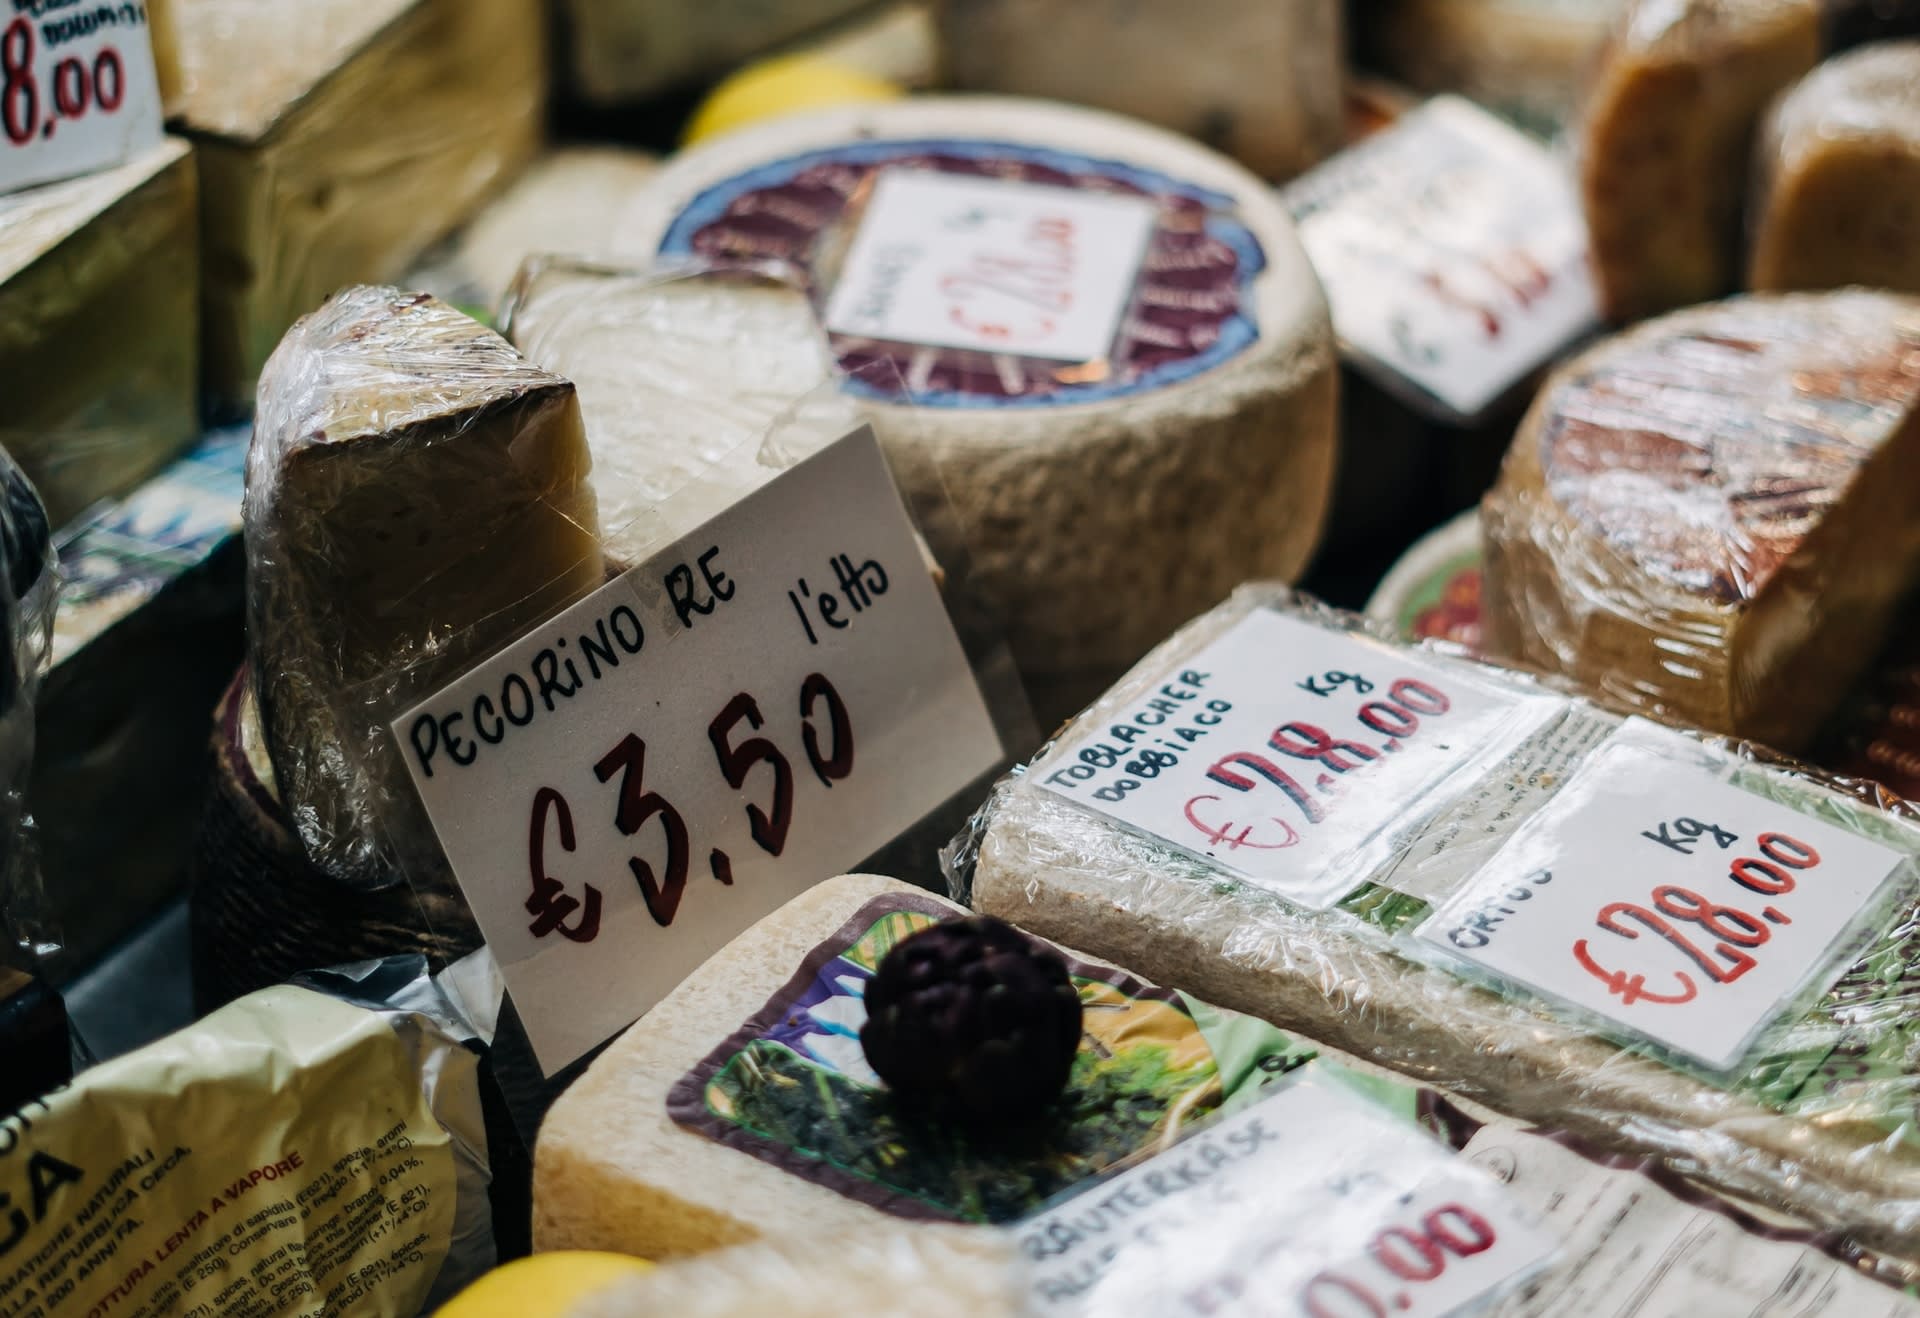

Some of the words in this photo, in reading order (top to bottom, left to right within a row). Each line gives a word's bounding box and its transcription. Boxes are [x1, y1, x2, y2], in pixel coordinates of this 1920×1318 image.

[663, 545, 737, 629] RE
[1044, 669, 1212, 789] TOBLACHER
[76, 1148, 156, 1227] NATURALI
[155, 1208, 210, 1262] LENTA
[211, 1197, 226, 1213] A
[224, 1150, 305, 1202] VAPORE
[233, 1221, 247, 1238] di
[246, 1199, 296, 1229] sapidità
[376, 1119, 408, 1149] aromi
[76, 1239, 119, 1281] ANNI
[228, 1215, 298, 1257] Conservare
[250, 1245, 288, 1277] natural
[259, 1272, 276, 1288] Do
[276, 1258, 296, 1276] not
